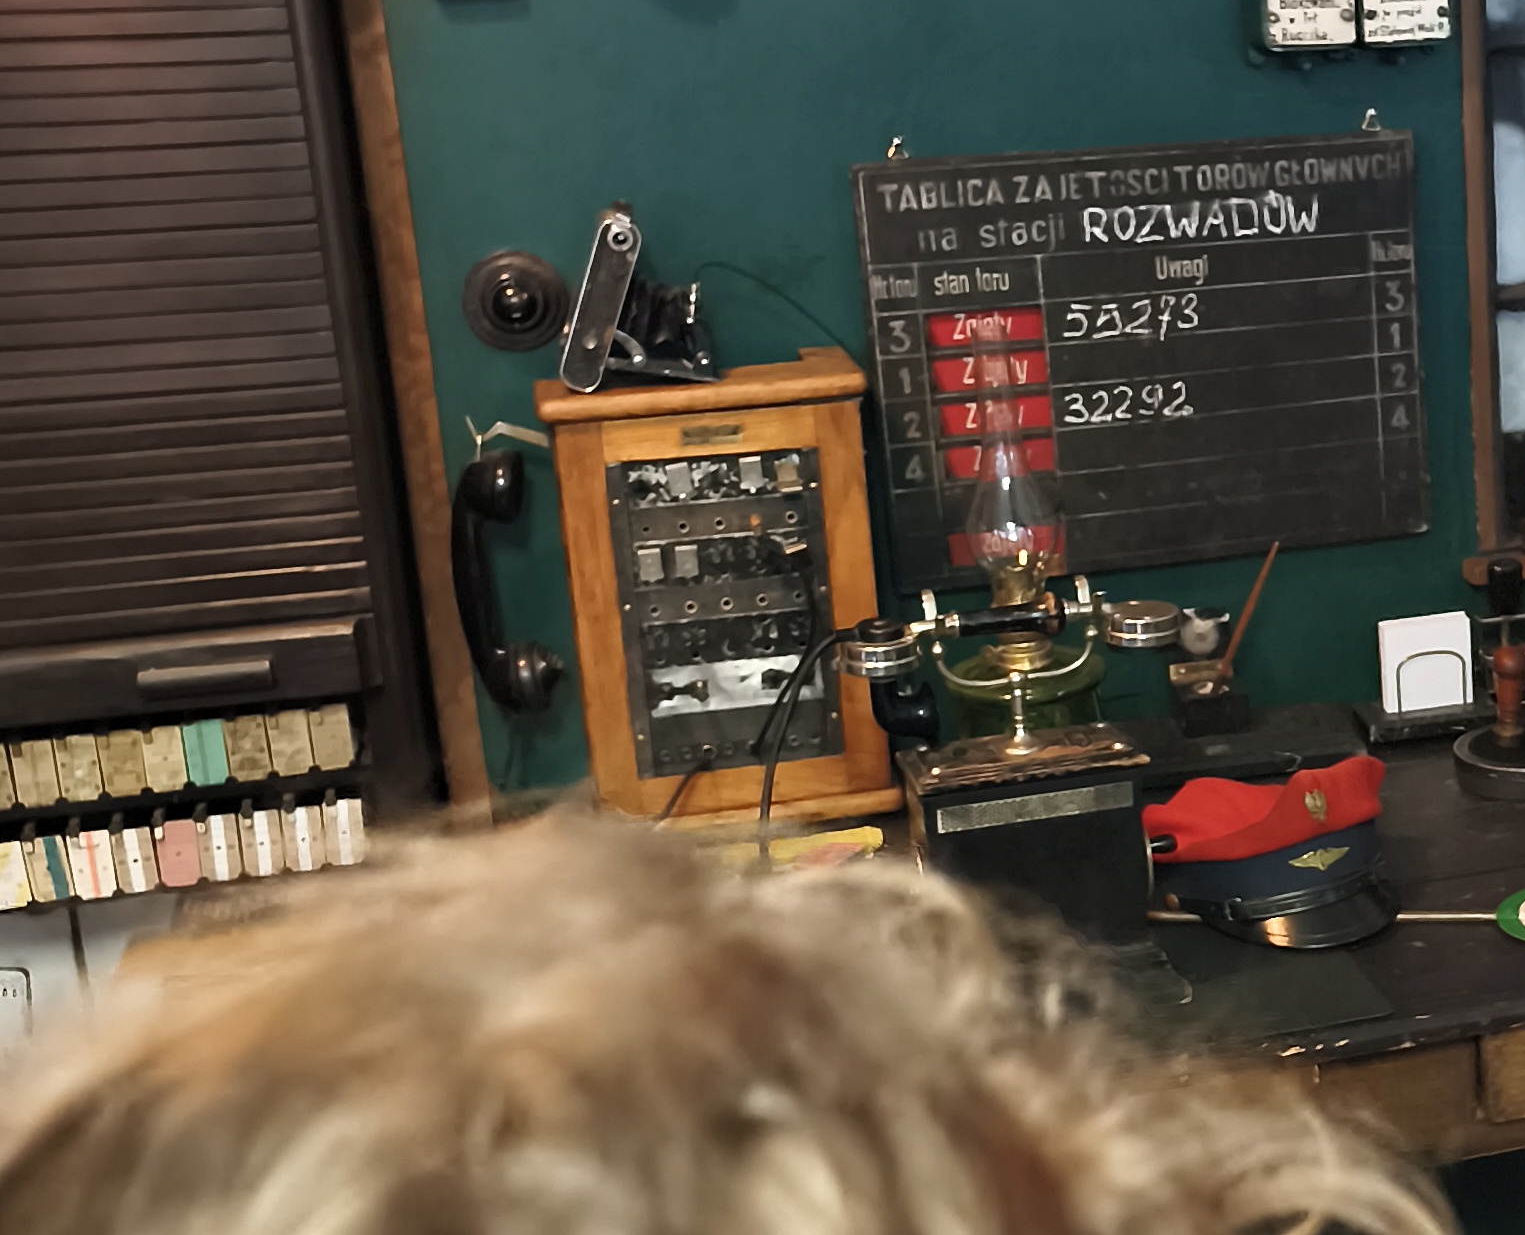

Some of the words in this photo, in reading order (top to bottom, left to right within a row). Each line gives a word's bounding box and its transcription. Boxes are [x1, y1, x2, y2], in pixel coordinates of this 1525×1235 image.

[876, 178, 1005, 213] TABLICA
[917, 227, 958, 253] na
[979, 213, 1066, 253] stacji
[934, 271, 970, 296] stan
[975, 267, 1010, 292] toru
[1385, 281, 1405, 312] 3
[888, 320, 911, 353] 3
[1390, 322, 1401, 349] 1
[898, 366, 911, 394] 1
[903, 413, 922, 438] 2
